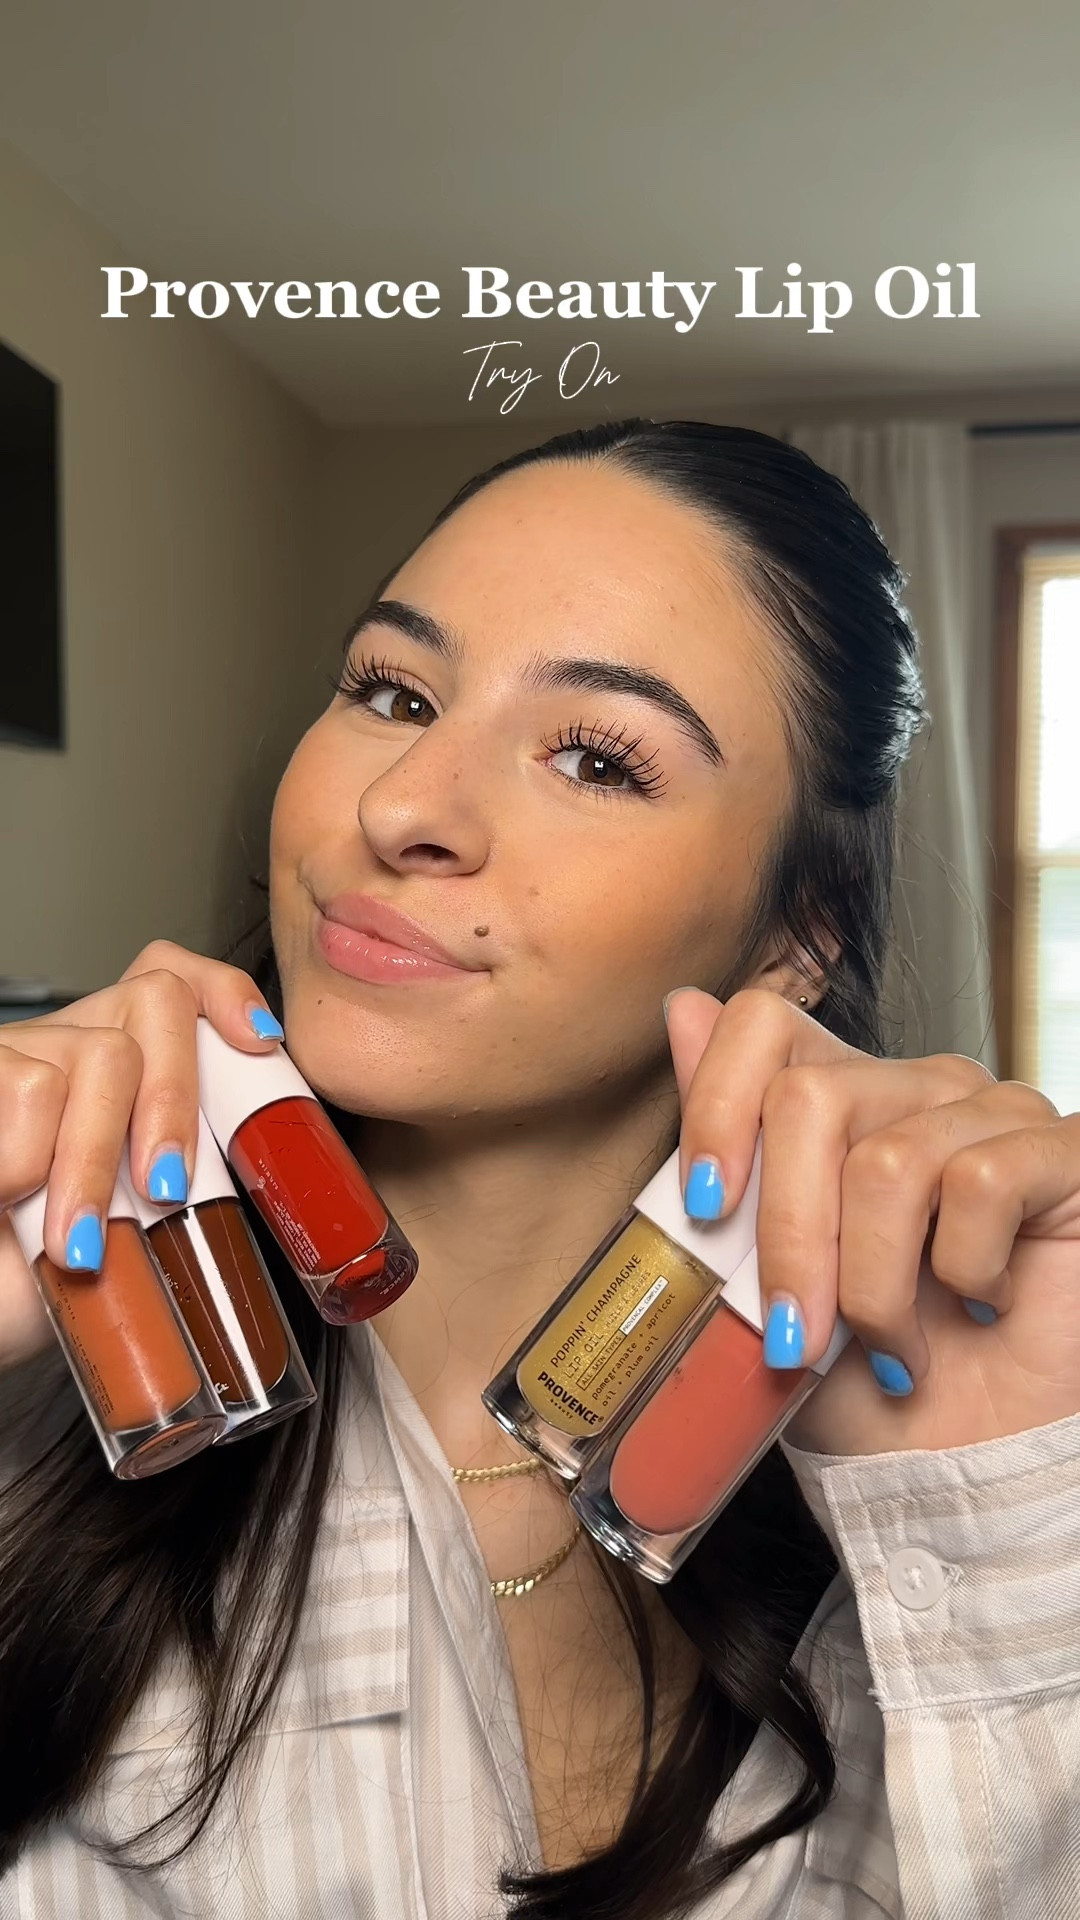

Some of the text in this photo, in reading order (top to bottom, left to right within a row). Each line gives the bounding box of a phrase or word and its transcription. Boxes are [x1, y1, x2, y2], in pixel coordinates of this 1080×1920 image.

[550, 1254, 641, 1368] POPPIN' CHAMPAGNE
[591, 1342, 637, 1401] pomegranate
[646, 1293, 676, 1330] apricot
[563, 1356, 581, 1378] LIP
[584, 1333, 604, 1353] OIL
[582, 1335, 622, 1386] ALL SKIN TYPES
[602, 1390, 617, 1407] oil
[625, 1355, 644, 1378] plum
[644, 1335, 659, 1352] oil
